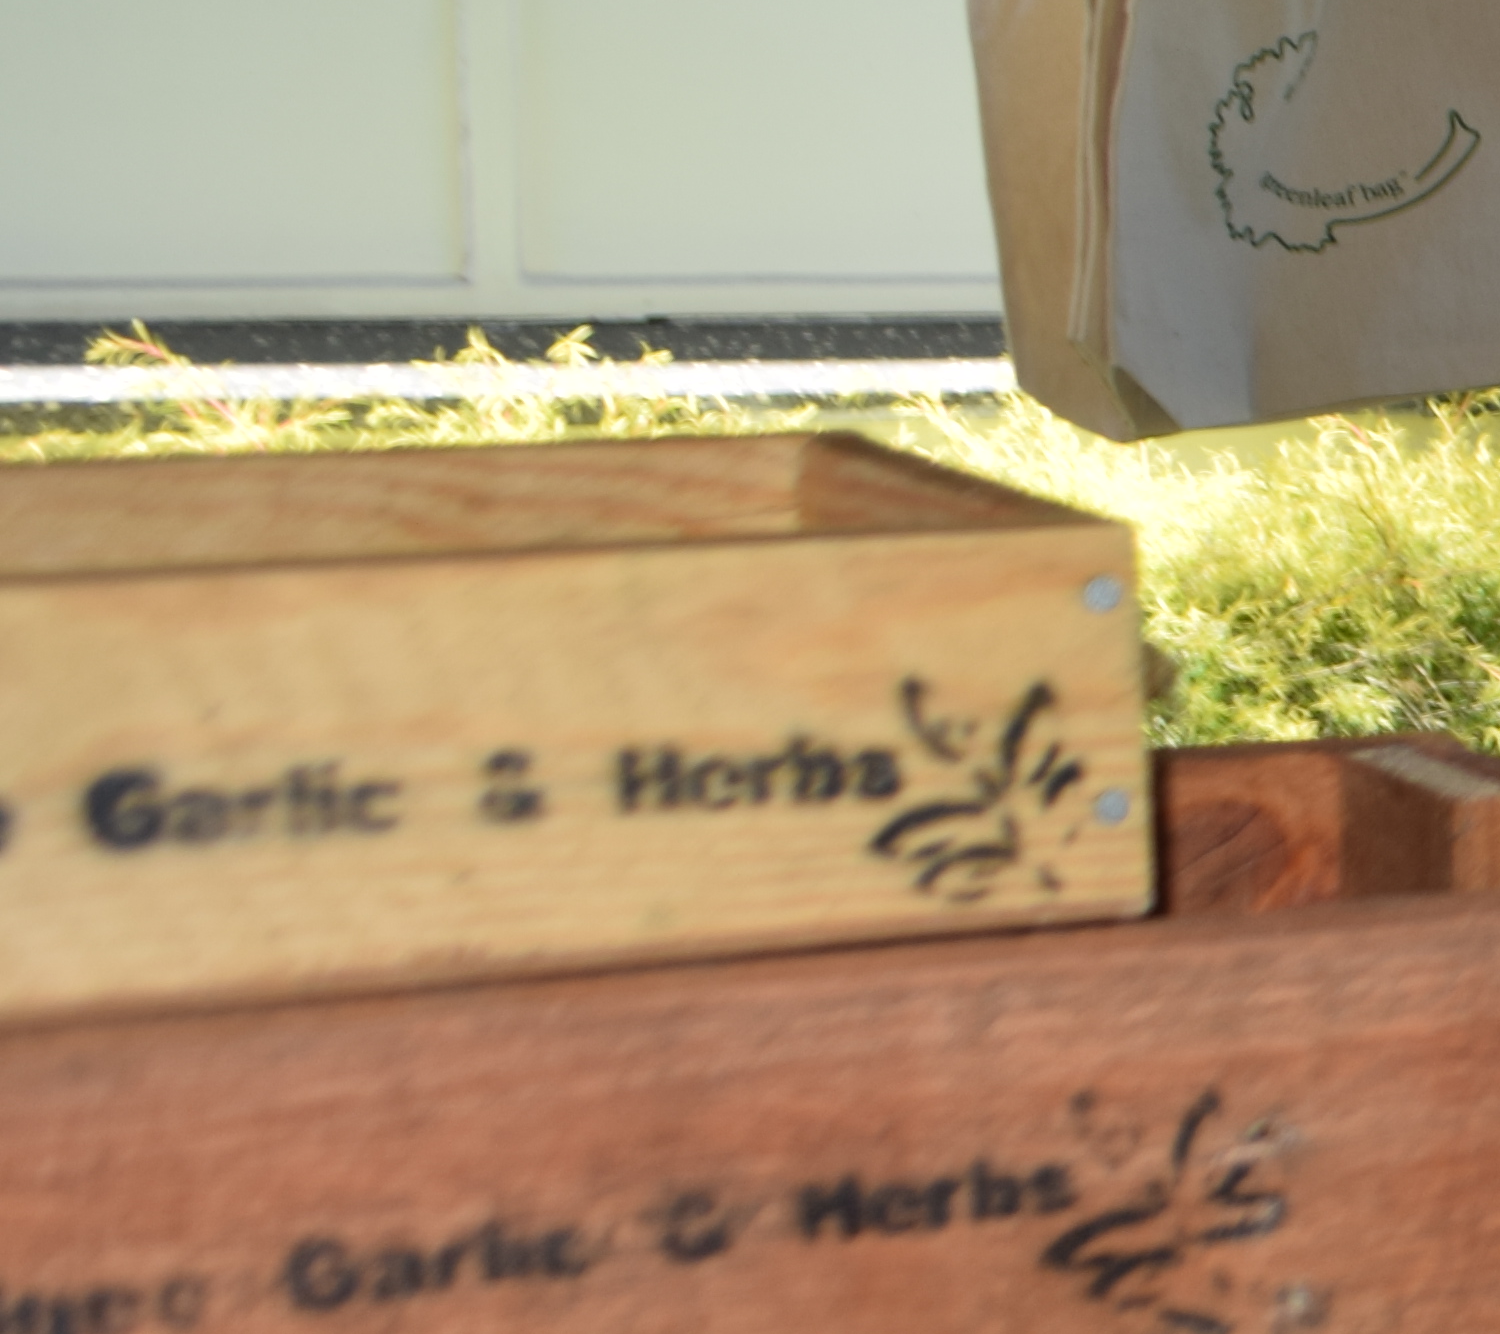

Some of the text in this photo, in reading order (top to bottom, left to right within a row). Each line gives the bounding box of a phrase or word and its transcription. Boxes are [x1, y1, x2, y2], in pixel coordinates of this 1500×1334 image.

[82, 755, 401, 849] Garlic
[614, 731, 905, 814] Herbs
[281, 1217, 593, 1313] Garlic
[797, 1156, 1078, 1243] Herbs
